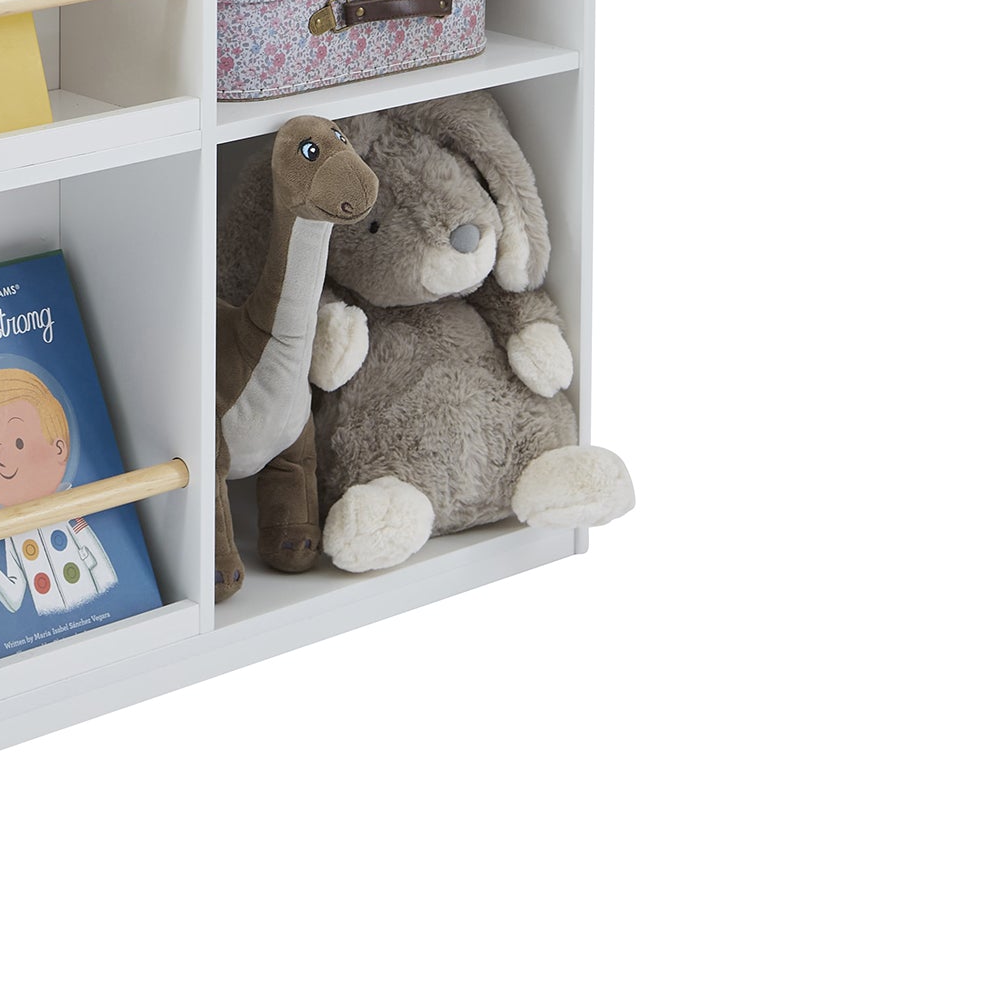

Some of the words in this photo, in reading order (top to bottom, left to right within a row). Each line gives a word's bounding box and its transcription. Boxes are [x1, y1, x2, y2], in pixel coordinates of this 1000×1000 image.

[3, 638, 26, 650] Written
[26, 635, 34, 643] by
[52, 625, 69, 635] Isabel
[91, 612, 111, 623] Vegara
